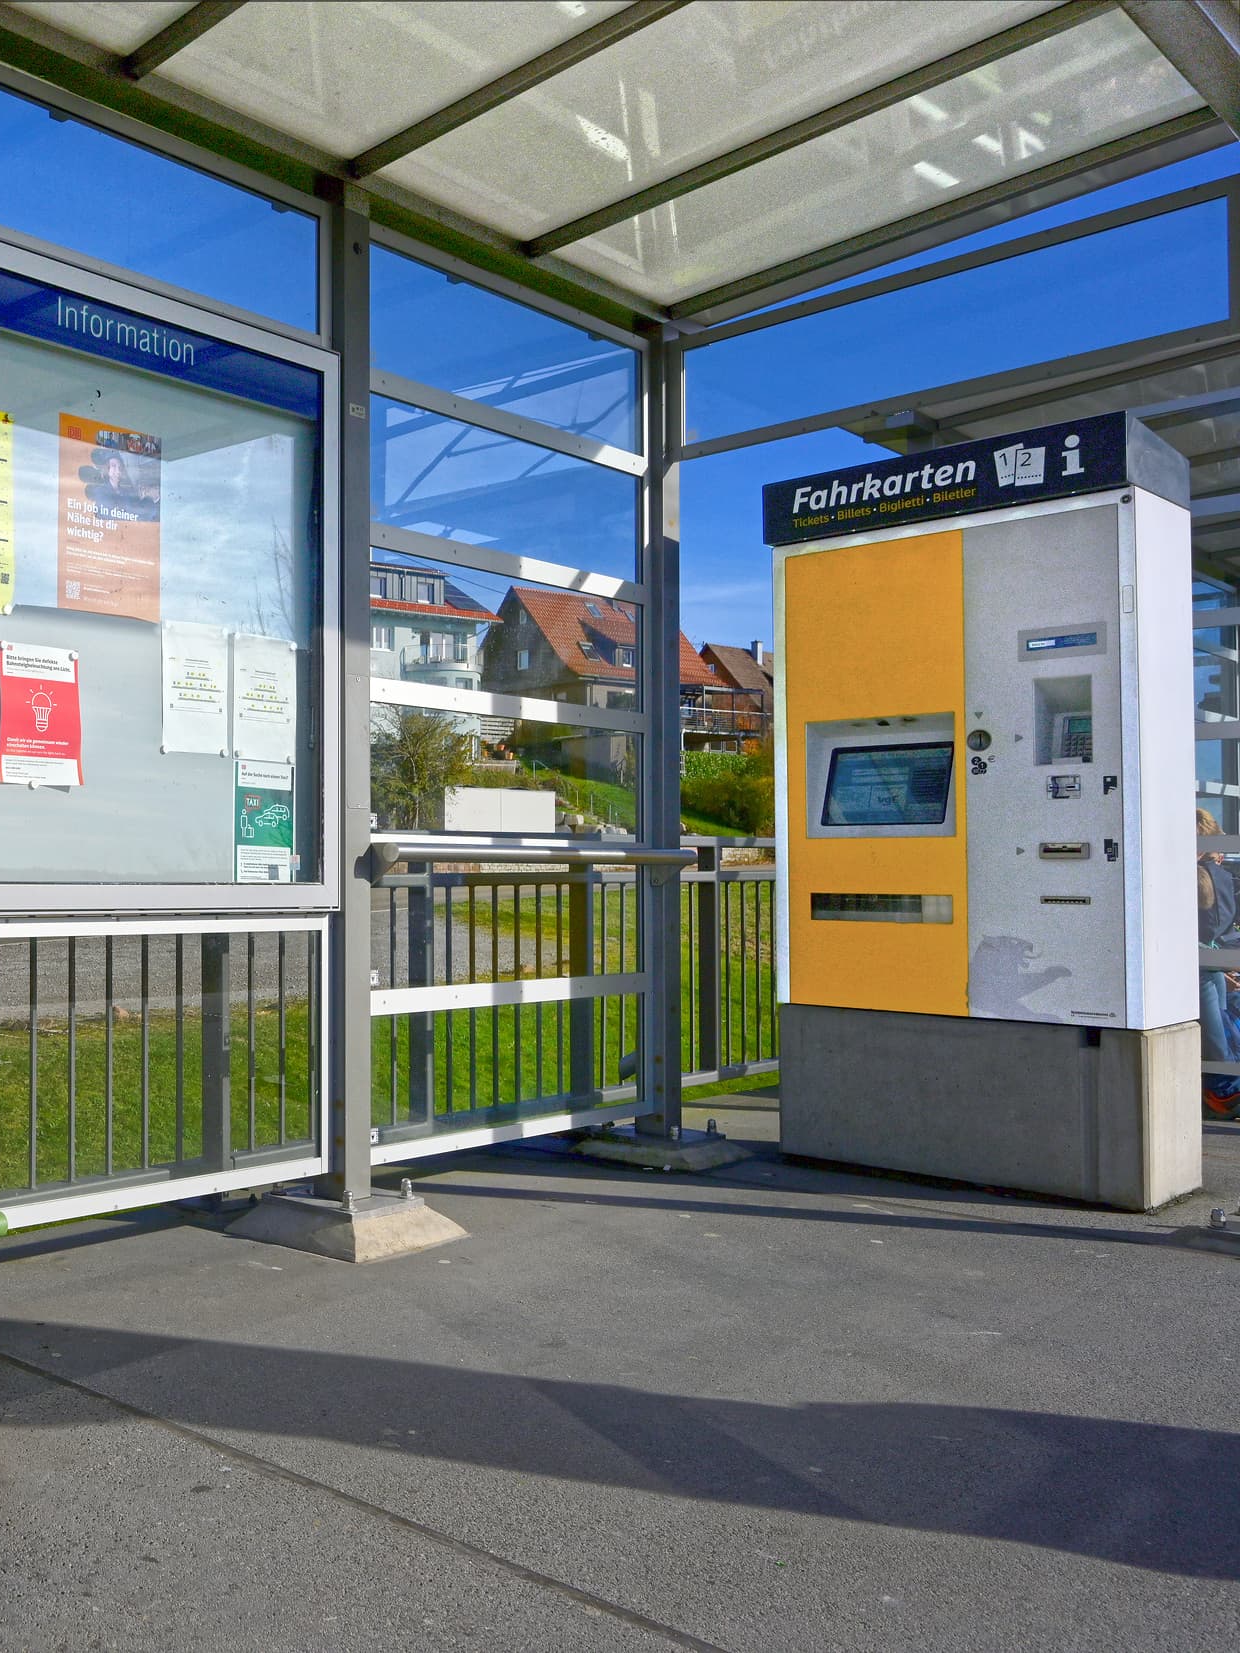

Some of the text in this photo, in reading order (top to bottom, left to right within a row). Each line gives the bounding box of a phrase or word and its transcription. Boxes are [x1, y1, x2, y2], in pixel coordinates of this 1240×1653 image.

[57, 295, 195, 366] Information
[792, 459, 976, 514] Fahrkarten
[67, 498, 139, 521] Ein Job in deiner
[793, 487, 976, 528] Tickets Billets Biglietti Biletler
[67, 511, 118, 531] Nähe ist dir
[67, 526, 104, 543] wichtig?
[246, 797, 259, 807] TAXI
